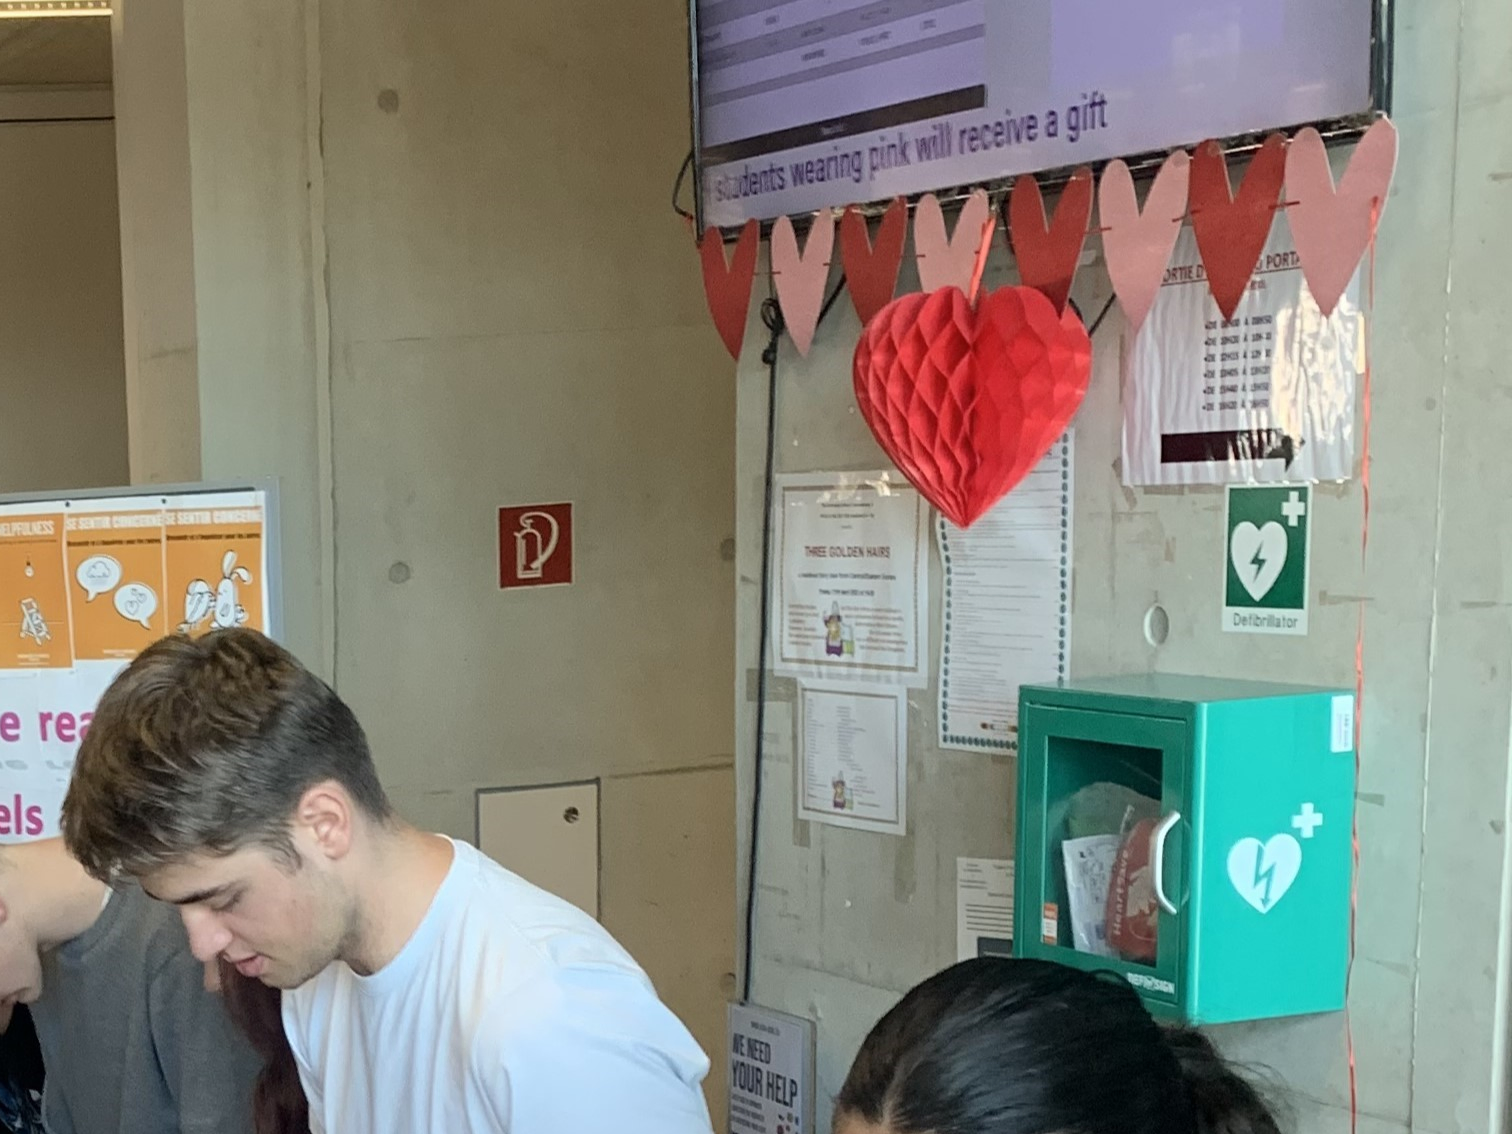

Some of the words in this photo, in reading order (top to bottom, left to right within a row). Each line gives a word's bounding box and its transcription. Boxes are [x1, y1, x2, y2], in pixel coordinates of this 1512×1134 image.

[715, 163, 785, 201] students
[790, 146, 862, 187] wearing
[869, 132, 911, 181] pink
[915, 121, 954, 162] will
[959, 109, 1038, 155] receive
[1045, 110, 1059, 138] a
[1066, 90, 1108, 142] gift
[1233, 612, 1298, 629] Defibrillator
[747, 1036, 771, 1065] NEED
[732, 1060, 763, 1098] YOUR
[766, 1070, 798, 1109] HELP
